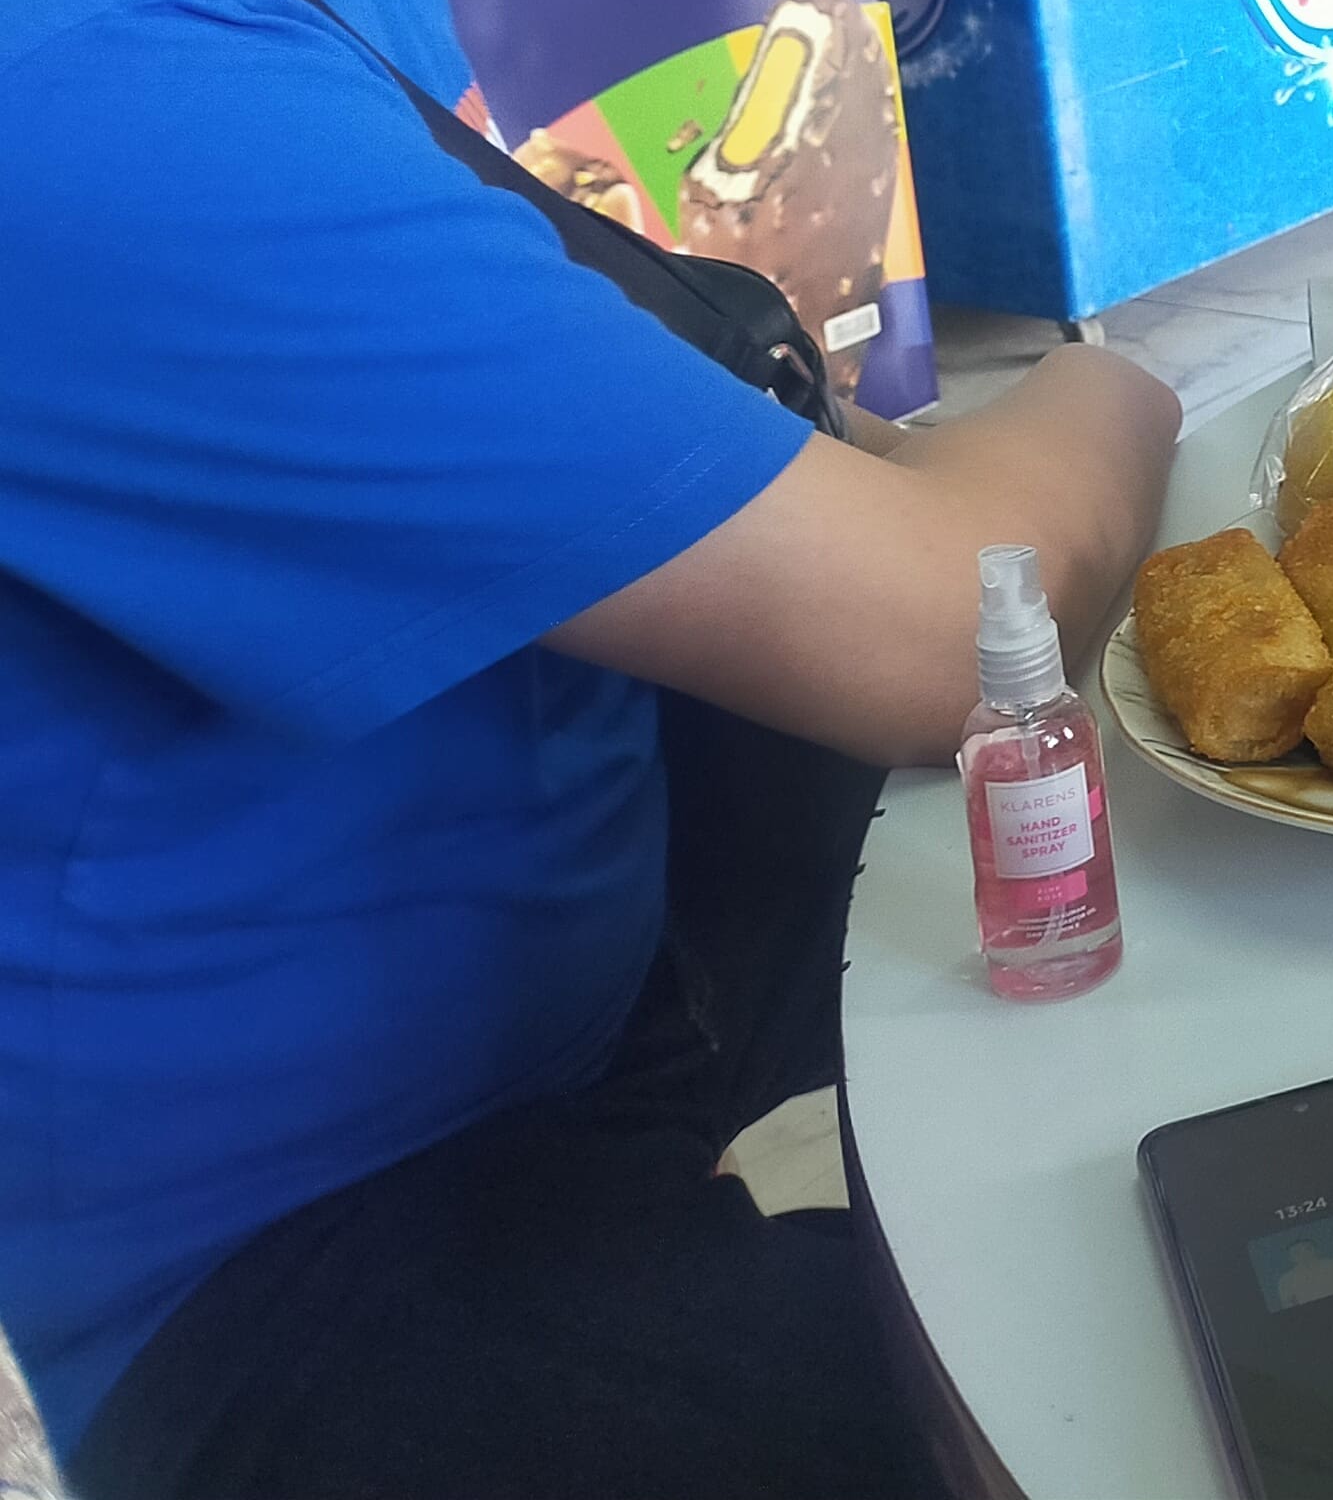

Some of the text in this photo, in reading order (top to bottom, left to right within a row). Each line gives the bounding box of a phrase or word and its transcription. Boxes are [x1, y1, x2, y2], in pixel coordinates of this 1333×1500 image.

[1000, 787, 1076, 812] KLARENS
[1006, 823, 1077, 847] SANITIZER
[1021, 816, 1061, 833] HAND
[1022, 841, 1066, 859] SPRAY
[1274, 1196, 1328, 1220] 13:24
